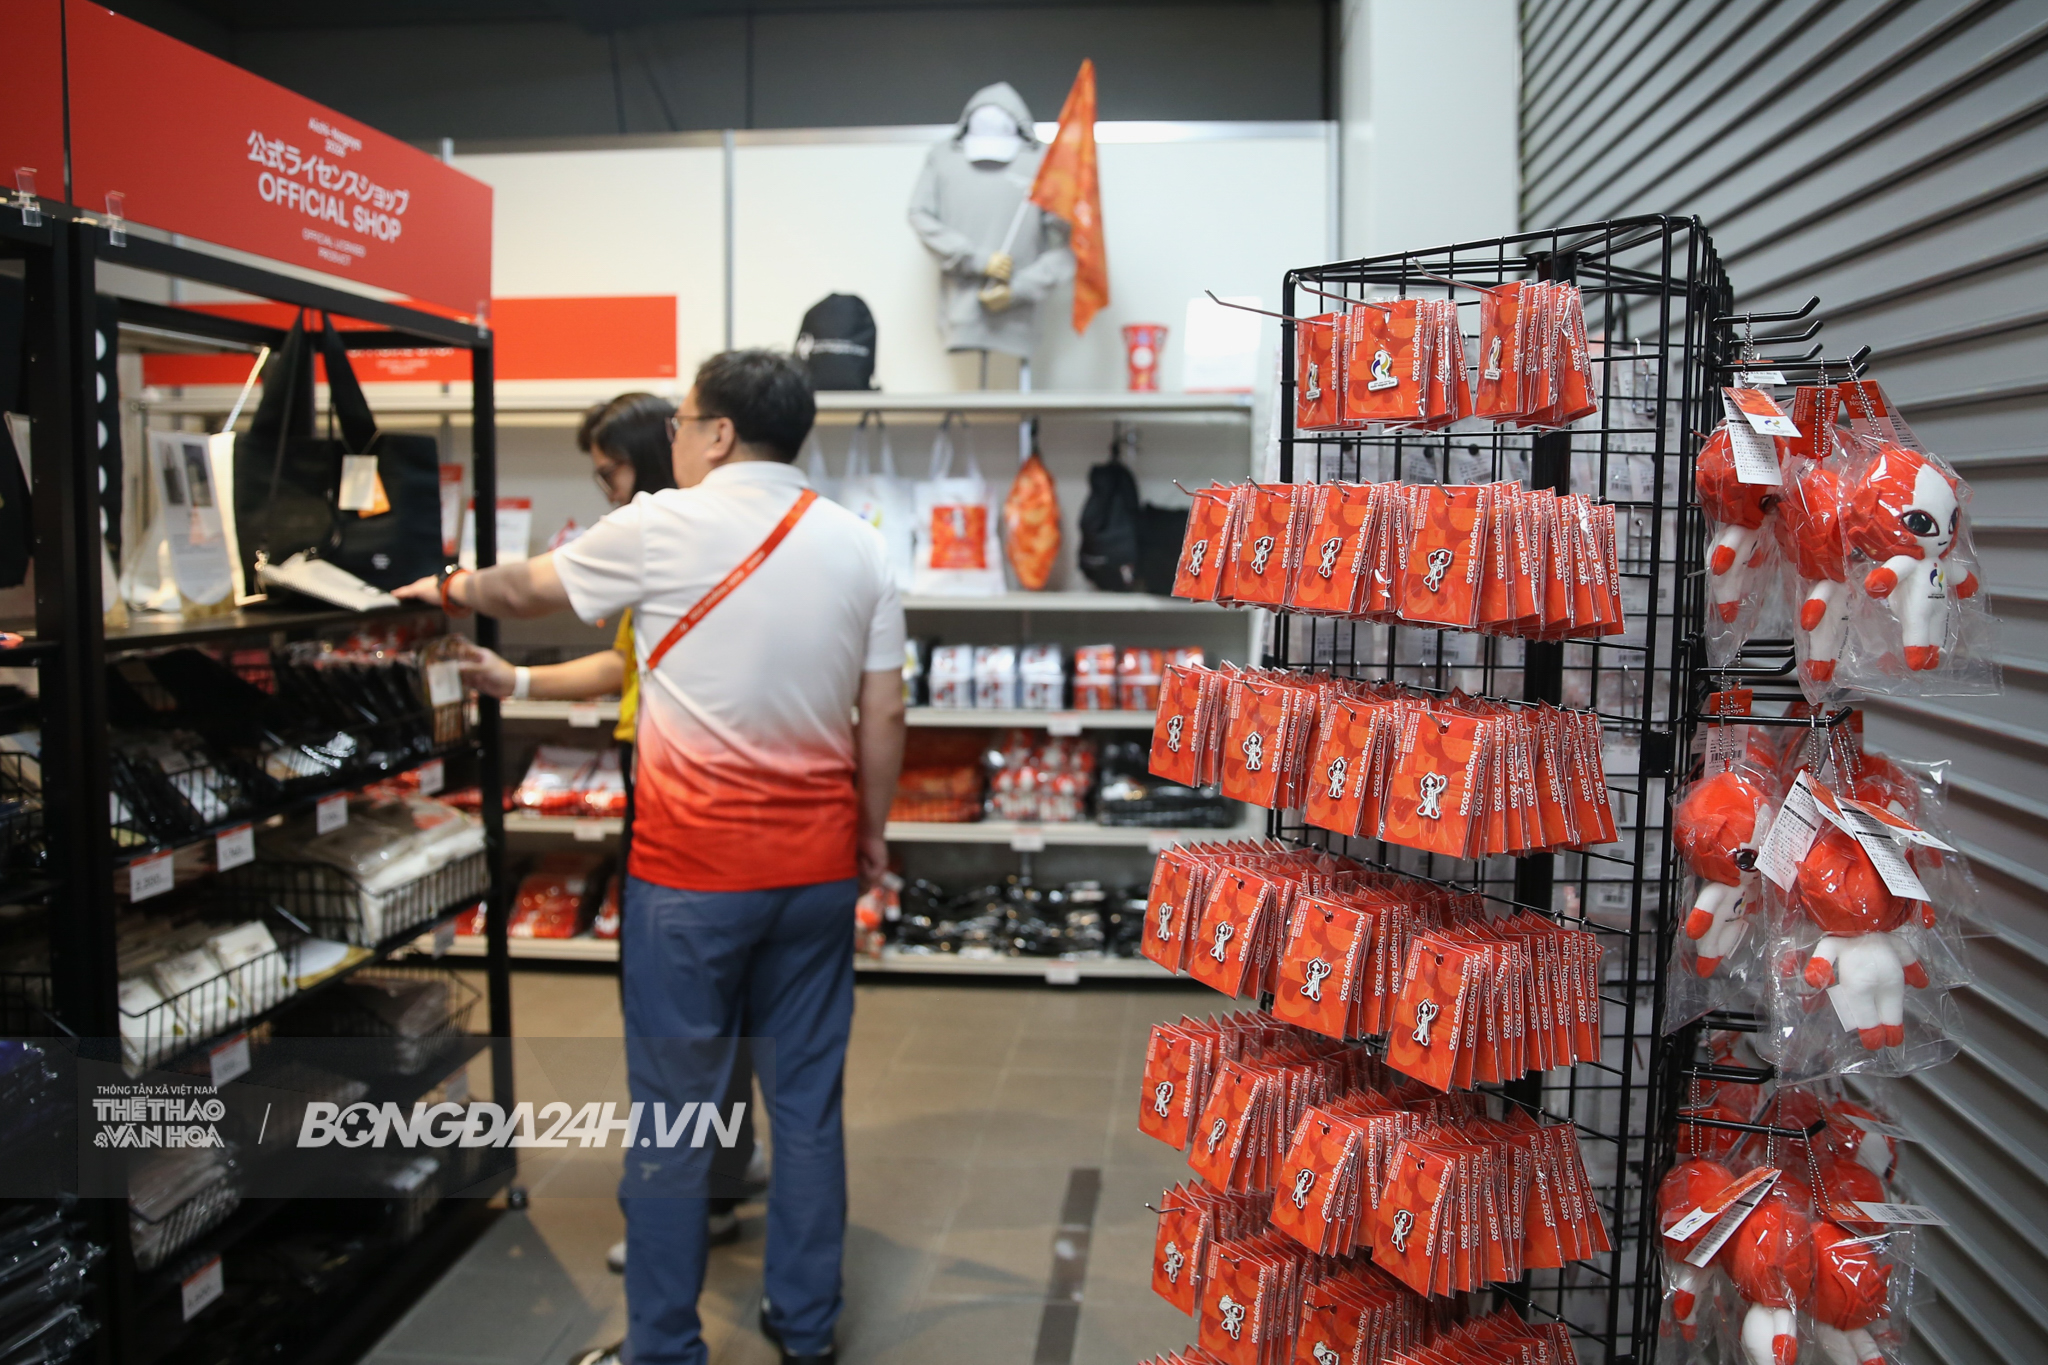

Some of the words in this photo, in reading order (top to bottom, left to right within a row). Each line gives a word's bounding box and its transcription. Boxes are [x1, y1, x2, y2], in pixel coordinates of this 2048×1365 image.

[247, 130, 409, 215] 公式ライセンスショップ
[258, 172, 349, 228] OFFICIAL
[353, 205, 402, 243] SHOP
[1412, 300, 1423, 358] Aichi-Nagoya
[1436, 301, 1444, 358] Aichi-Nagoya
[1513, 281, 1526, 346] Aichi-Nagoya
[1527, 286, 1540, 350] Aichi-Nagoya
[1458, 360, 1466, 381] 2026
[1525, 353, 1533, 375] 2026
[1285, 485, 1297, 544] Aichi-Nagoya
[1356, 485, 1375, 553] Aichi-Nagoya
[1380, 485, 1390, 548] Aichi-Nagoya
[1393, 482, 1404, 547] Aichi-Nagoya
[1468, 487, 1485, 556] Aichi-Nagoya
[1494, 485, 1503, 552] Aichi-Nagoya
[1511, 484, 1525, 549] Aichi-Nagoya
[1519, 551, 1528, 575] 2026
[1546, 490, 1560, 555] Aichi-Nagoya
[1607, 506, 1615, 571] Aichi-Nagoya
[1214, 548, 1224, 568] 2026
[1351, 551, 1361, 574] 2026
[1379, 550, 1387, 573] 2026
[1398, 547, 1407, 570] 2026
[1466, 559, 1476, 584] 2026
[1496, 554, 1504, 580] 2026
[1593, 561, 1604, 586] 2026
[1609, 572, 1618, 596] 2026
[1193, 673, 1204, 730] Aichi-Nagoya
[1275, 689, 1289, 749] Aichi-Nagoya
[1288, 689, 1302, 749] Aichi-Nagoya
[1191, 732, 1199, 752] 2026
[1284, 750, 1292, 772] 2026
[1360, 709, 1377, 772] Aichi-Nagoya
[1375, 707, 1385, 772] Aichi-Nagoya
[1465, 721, 1484, 789] Aichi-Nagoya
[1493, 717, 1503, 784] Aichi-Nagoya
[1506, 715, 1515, 781] Aichi-Nagoya
[1516, 713, 1530, 780] Aichi-Nagoya
[1525, 782, 1534, 807] 2026
[1538, 711, 1553, 776] Aichi-Nagoya
[1550, 779, 1559, 802] 2026
[1587, 716, 1599, 779] Aichi-Nagoya
[1595, 782, 1606, 804] 2026
[1354, 774, 1363, 798] 2026
[1460, 790, 1471, 816] 2026
[1510, 784, 1518, 808] 2026
[1580, 777, 1591, 801] 2026
[1182, 865, 1195, 919] Aichi-Nagoya
[1244, 882, 1268, 939] Aichi-Nagoya
[1178, 921, 1186, 941] 2026
[1239, 941, 1248, 961] 2026
[1343, 913, 1365, 976] Aichi-Nagoya
[1375, 908, 1387, 971] Aichi-Nagoya
[1390, 905, 1399, 969] Aichi-Nagoya
[1340, 978, 1350, 1001] 2026
[1375, 973, 1383, 996] 2026
[1454, 956, 1470, 1025] Aichi-Nagoya
[1468, 953, 1481, 1021] Aichi-Nagoya
[1512, 945, 1522, 1011] Aichi-Nagoya
[1537, 938, 1546, 1003] Aichi-Nagoya
[1548, 933, 1560, 998] Aichi-Nagoya
[1556, 1002, 1564, 1025] 2026
[1571, 932, 1582, 996] Aichi-Nagoya
[1578, 999, 1587, 1023] 2026
[1587, 933, 1595, 998] Aichi-Nagoya
[1449, 1026, 1459, 1050] 2026
[1466, 1023, 1474, 1048] 2026
[1541, 1006, 1549, 1030] 2026
[1590, 1000, 1598, 1023] 2026
[1185, 1041, 1195, 1096] Aichi-Nagoya
[1183, 1098, 1191, 1117] 2026
[1236, 1079, 1259, 1136] Aichi-Nagoya
[1262, 1076, 1272, 1134] Aichi-Nagoya
[1230, 1138, 1240, 1158] 2026
[1246, 1137, 1255, 1158] 2026
[1329, 1130, 1355, 1191] Aichi-Nagoya
[1369, 1120, 1377, 1184] Aichi-Nagoya
[1560, 1129, 1577, 1193] Aichi-Nagoya
[1573, 1196, 1583, 1219] 2026
[1369, 1187, 1377, 1209] 2026
[1430, 1168, 1450, 1230] Aichi-Nagoya
[1458, 1154, 1467, 1221] Aichi-Nagoya
[1512, 1147, 1521, 1213] Aichi-Nagoya
[1559, 1197, 1569, 1220] 2026
[1584, 1190, 1595, 1213] 2026
[1191, 1212, 1206, 1270] Aichi-Nagoya
[1426, 1232, 1435, 1256] 2026
[1489, 1217, 1499, 1241] 2026
[1542, 1203, 1551, 1227] 2026
[1253, 1266, 1267, 1322] Aichi-Nagoya
[1251, 1324, 1259, 1344] 2026
